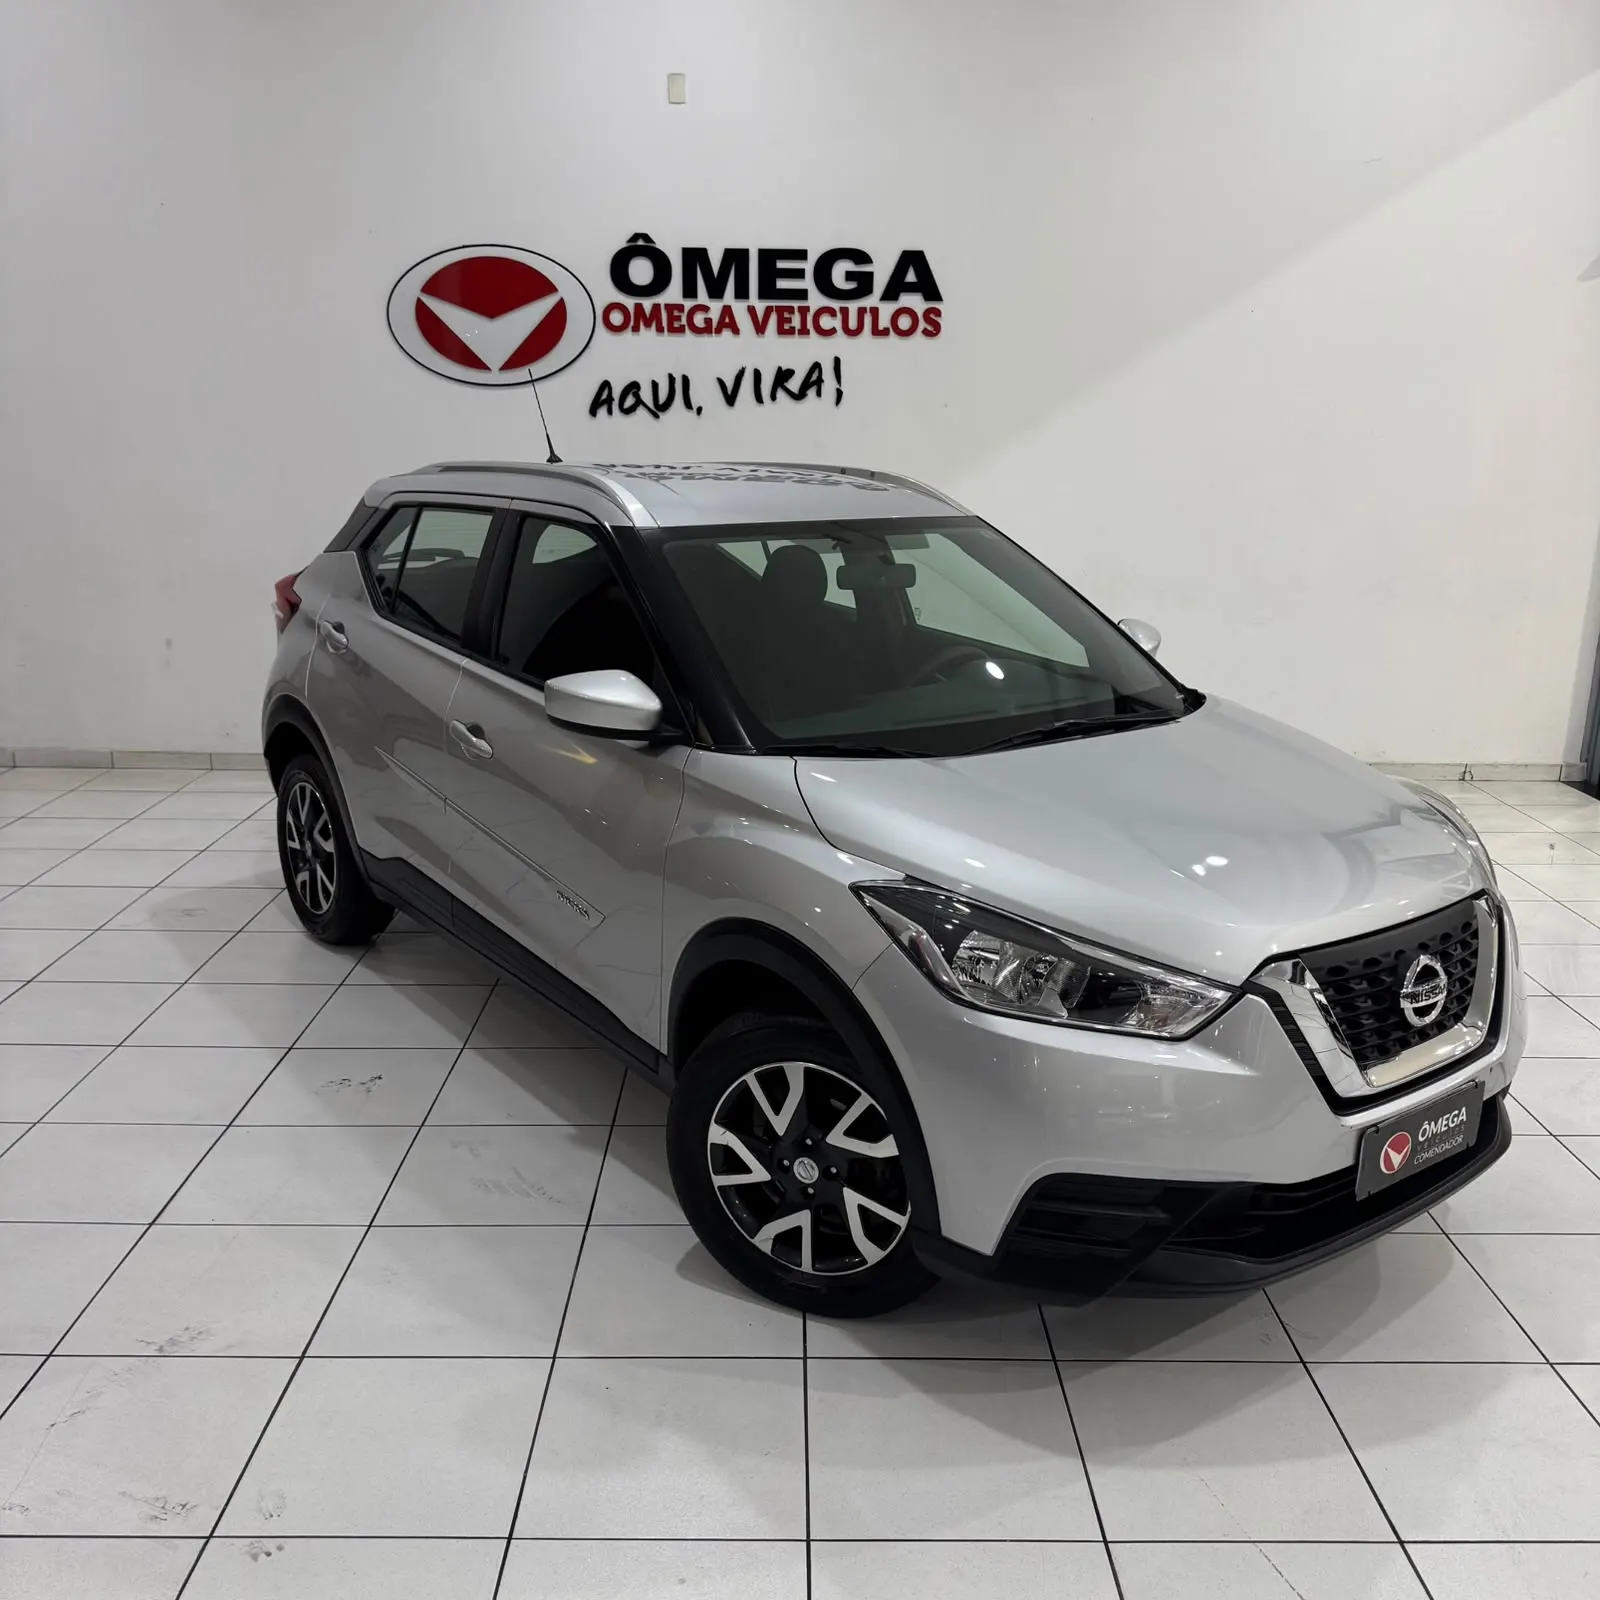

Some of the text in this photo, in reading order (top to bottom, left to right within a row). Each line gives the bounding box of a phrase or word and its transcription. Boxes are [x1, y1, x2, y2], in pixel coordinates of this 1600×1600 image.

[609, 232, 944, 302] ÔMEGA
[602, 302, 943, 338] OMEGA VEICULOS
[589, 355, 843, 419] AQUI, VIRA!
[1418, 1106, 1466, 1142] ÔMEGA
[1414, 1134, 1464, 1165] COMENDADOR
